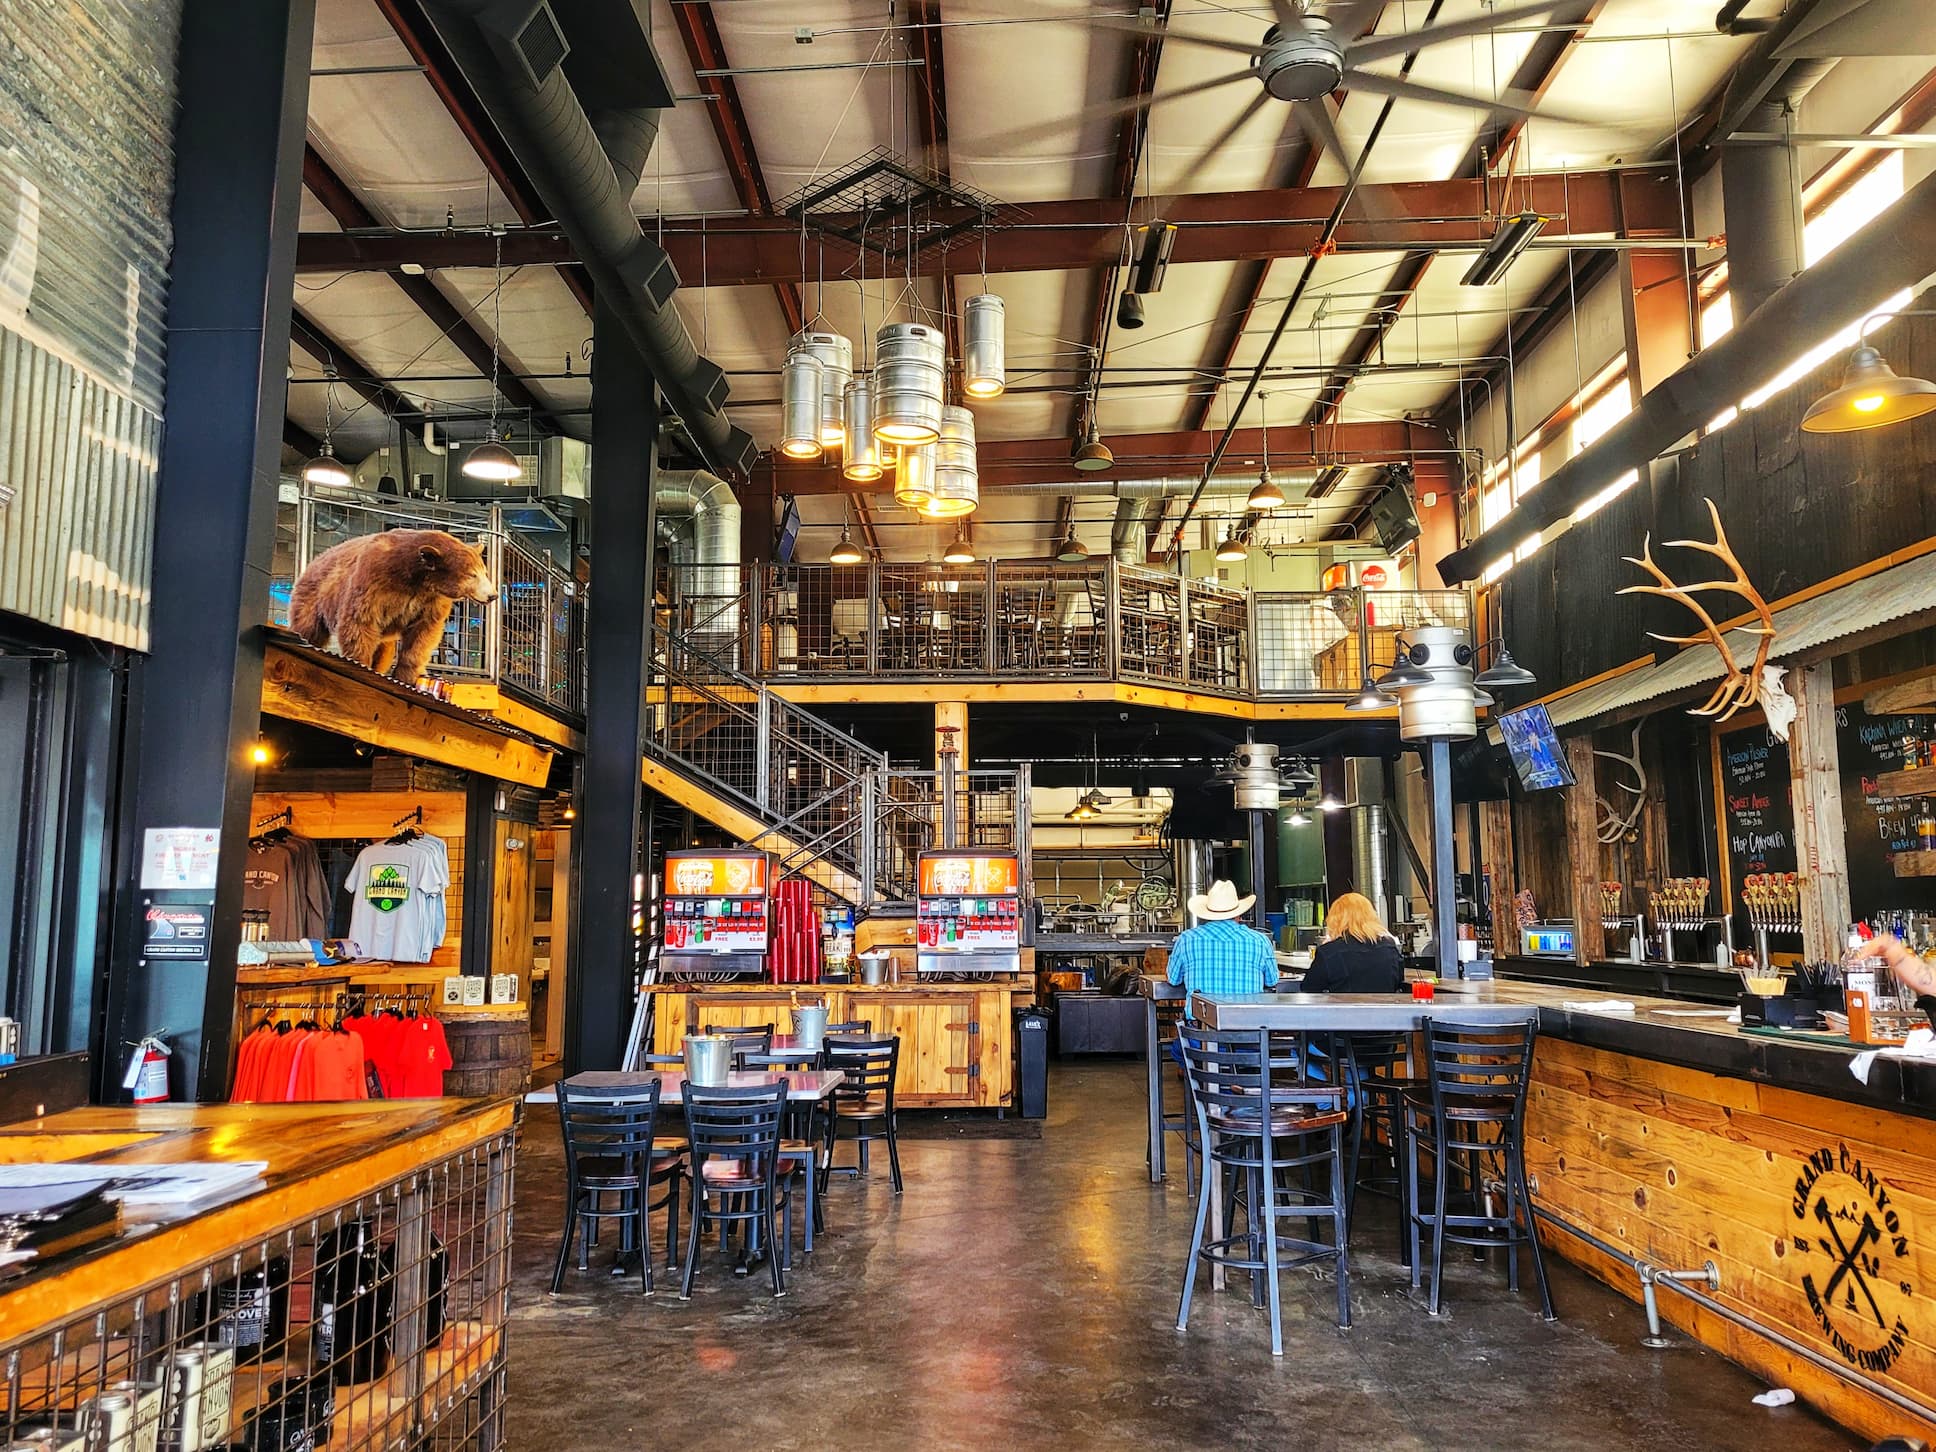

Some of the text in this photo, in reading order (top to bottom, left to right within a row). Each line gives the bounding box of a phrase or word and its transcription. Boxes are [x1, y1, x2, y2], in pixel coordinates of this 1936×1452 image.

[1749, 831, 1776, 854] CANYON
[1879, 816, 1907, 840] BREW
[1793, 1142, 1909, 1258] GRAND CANYON
[1801, 1272, 1909, 1373] BREWING COMPANY
